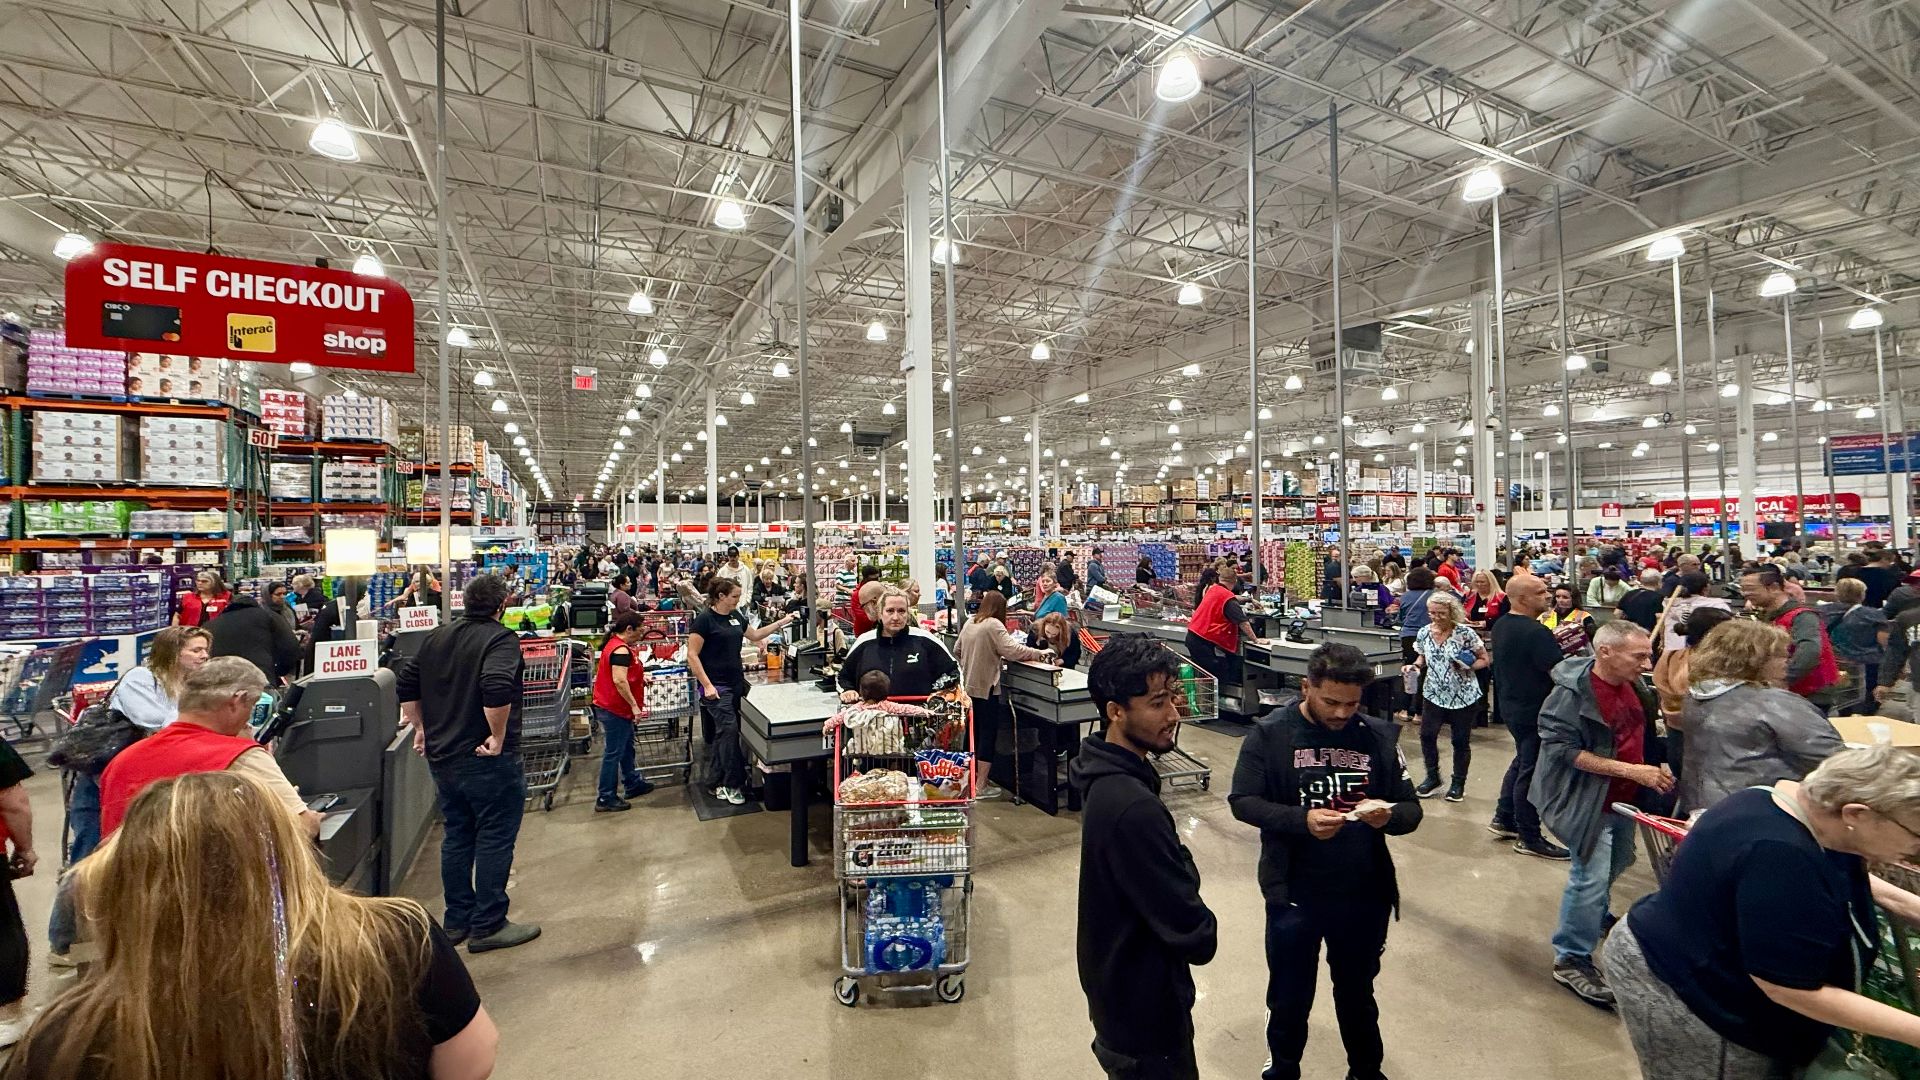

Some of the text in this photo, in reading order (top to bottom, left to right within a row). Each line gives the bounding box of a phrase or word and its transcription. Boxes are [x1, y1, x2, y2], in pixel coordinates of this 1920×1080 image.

[103, 258, 385, 313] SELF CHECKOUT
[229, 325, 273, 336] Interac
[323, 330, 387, 354] shop
[251, 432, 277, 447] 501
[397, 463, 412, 473] 503
[477, 479, 490, 487] 505
[493, 487, 503, 496] 507
[1725, 500, 1789, 513] OICAL
[409, 609, 429, 618] LANE
[405, 619, 434, 628] CLOSED
[330, 645, 361, 658] LANE
[322, 659, 367, 673] CLOSED
[918, 758, 967, 781] Ruffles
[876, 842, 913, 857] ZERO
